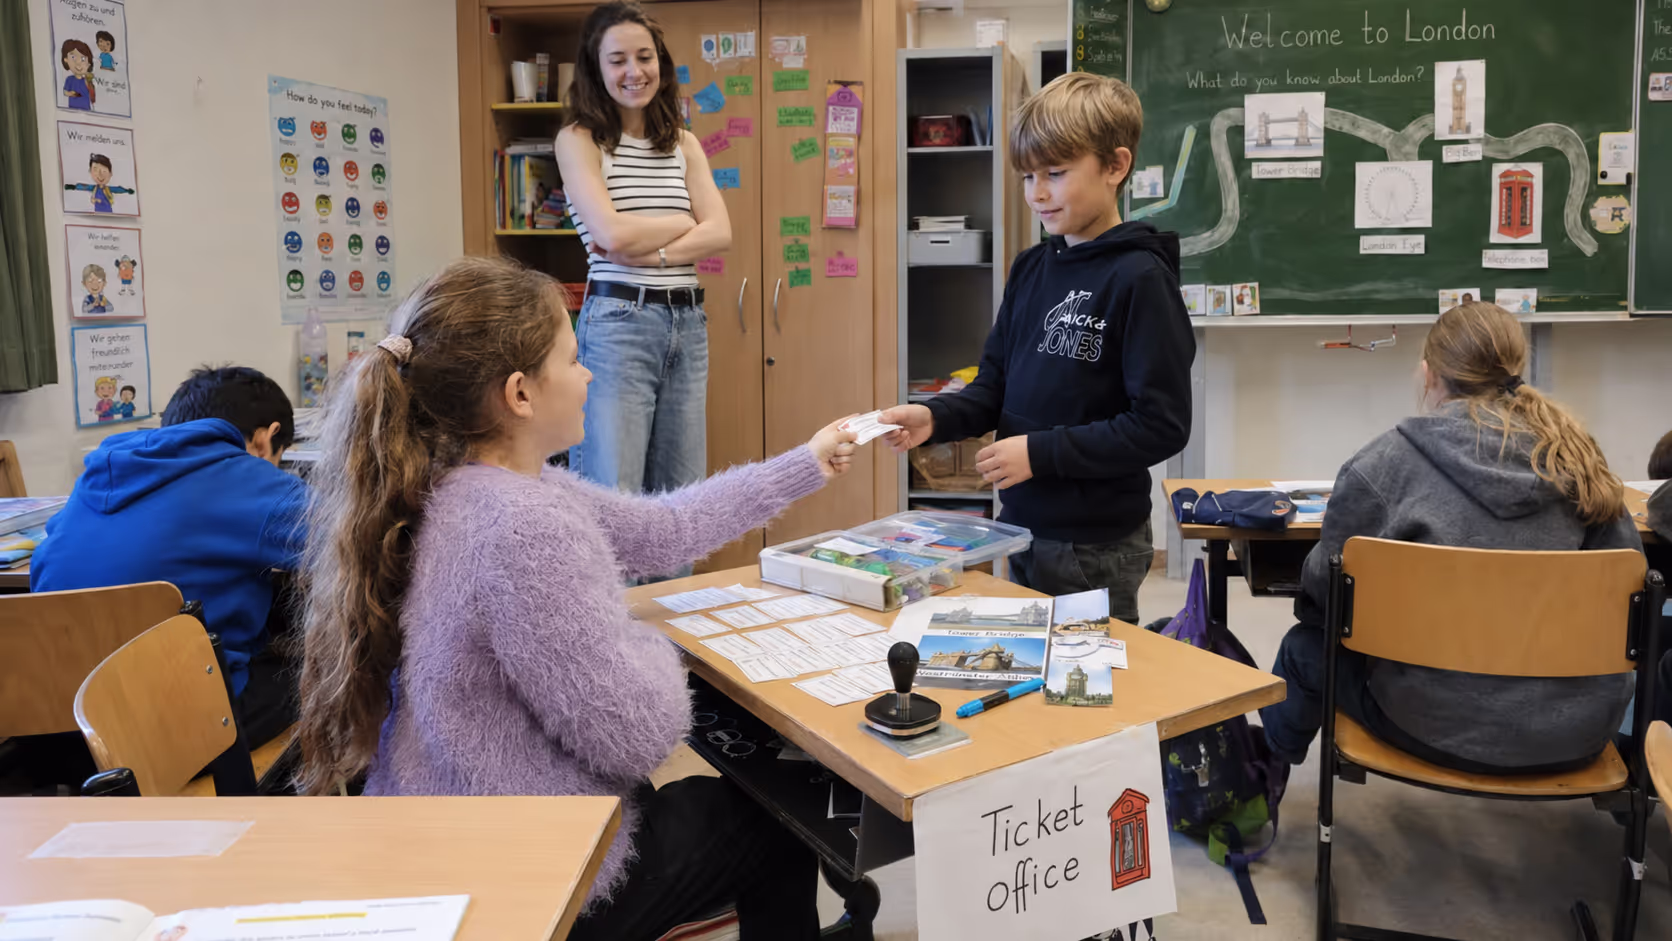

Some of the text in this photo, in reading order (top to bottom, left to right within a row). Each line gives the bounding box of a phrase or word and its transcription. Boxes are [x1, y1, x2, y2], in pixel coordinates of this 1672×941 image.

[100, 8, 115, 16] und
[1221, 7, 1496, 49] Welcome to London
[1186, 65, 1425, 93] What do you know about London?
[286, 89, 378, 119] How do you feel today?
[67, 130, 83, 141] Wir
[85, 132, 111, 144] melden
[1256, 164, 1320, 177] Tower Bridge
[1362, 239, 1422, 253] London Eye
[89, 333, 130, 345] Wir gehen
[981, 785, 1084, 857] Ticket
[986, 857, 1080, 915] office
